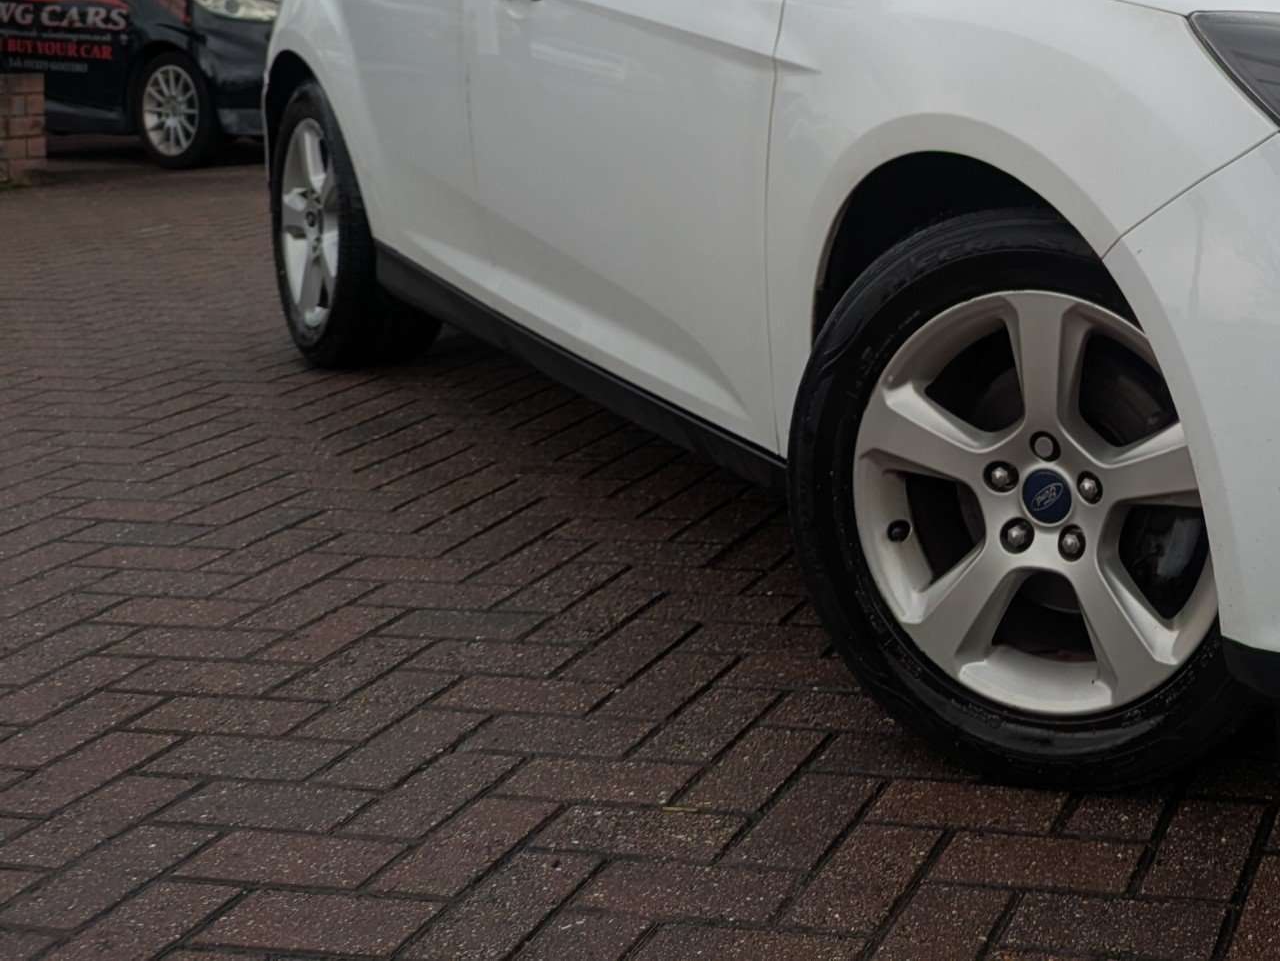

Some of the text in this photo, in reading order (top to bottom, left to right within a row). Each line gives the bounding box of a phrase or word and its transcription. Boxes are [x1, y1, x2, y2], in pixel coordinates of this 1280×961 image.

[40, 4, 128, 31] CARS
[7, 40, 113, 60] BUY YOUR CAR
